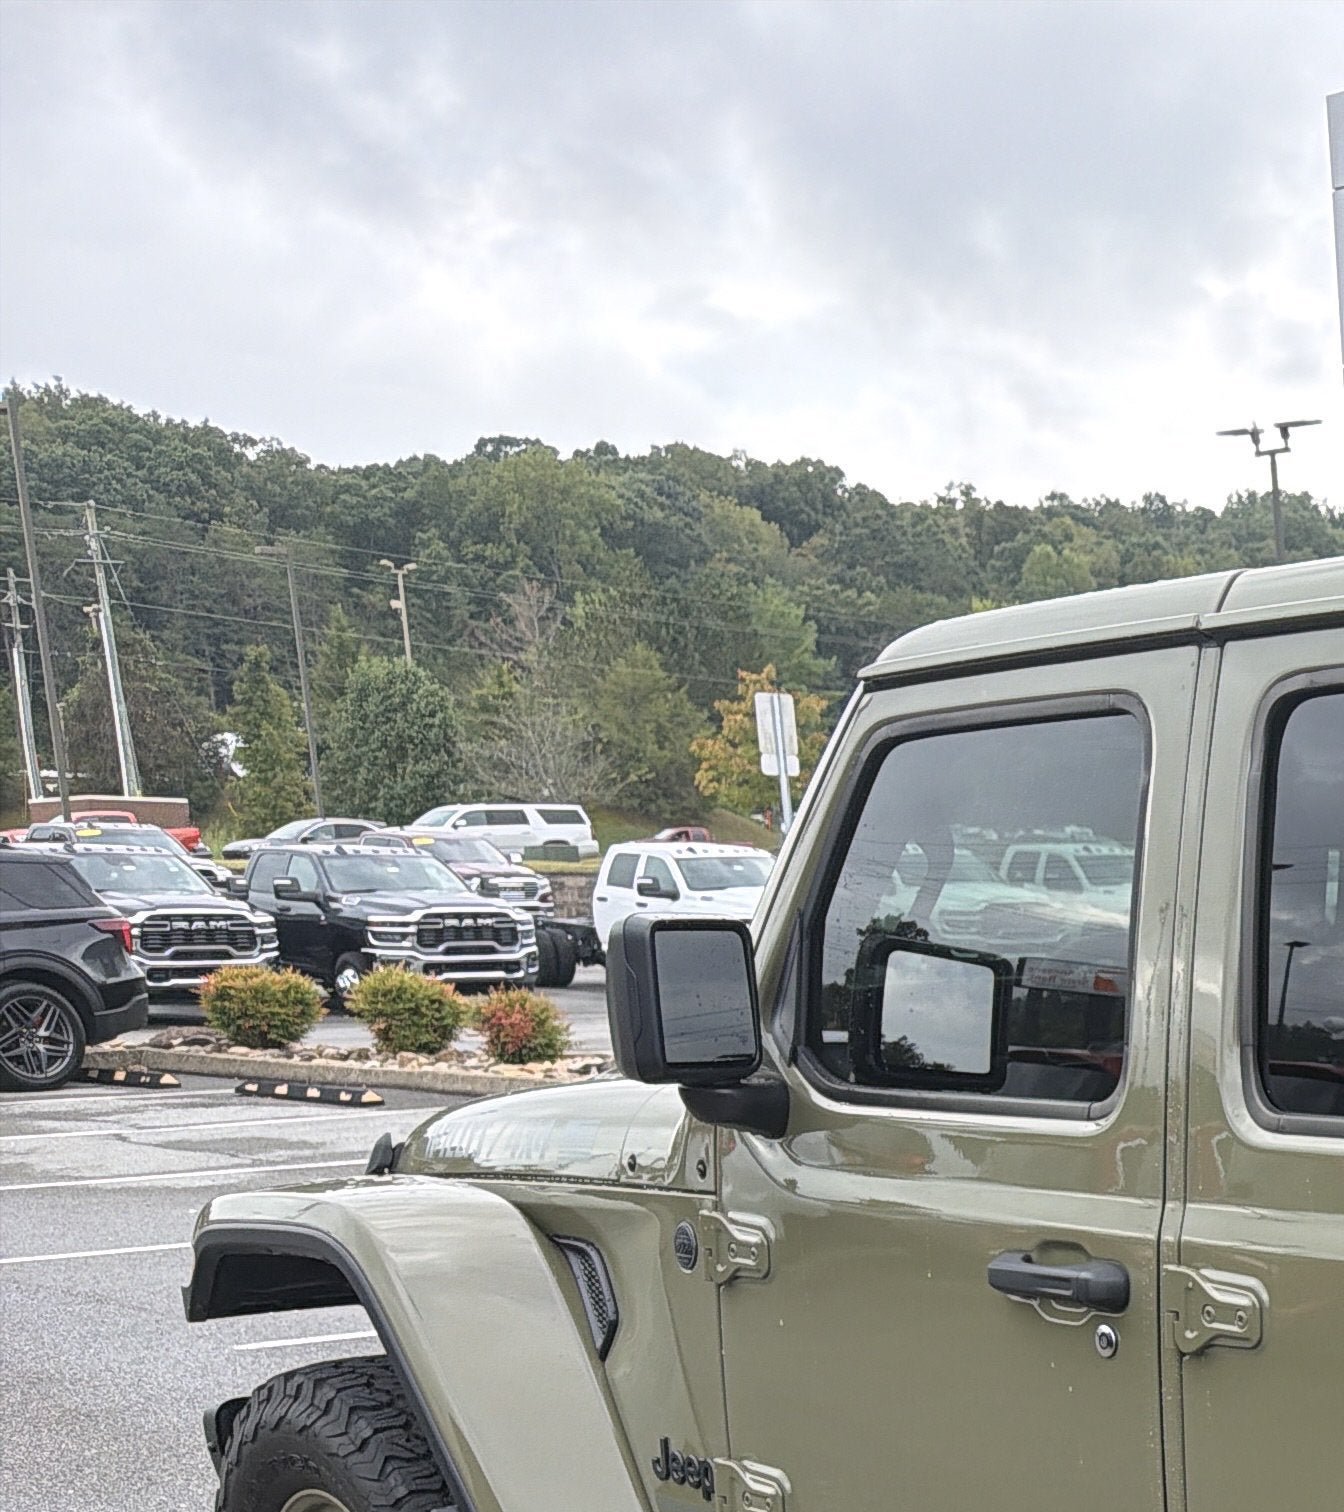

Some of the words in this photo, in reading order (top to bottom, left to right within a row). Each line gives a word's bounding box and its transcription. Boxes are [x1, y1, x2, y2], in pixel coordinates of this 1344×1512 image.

[171, 920, 228, 931] RAM
[443, 917, 494, 928] RAM
[651, 1435, 715, 1502] Jeep
